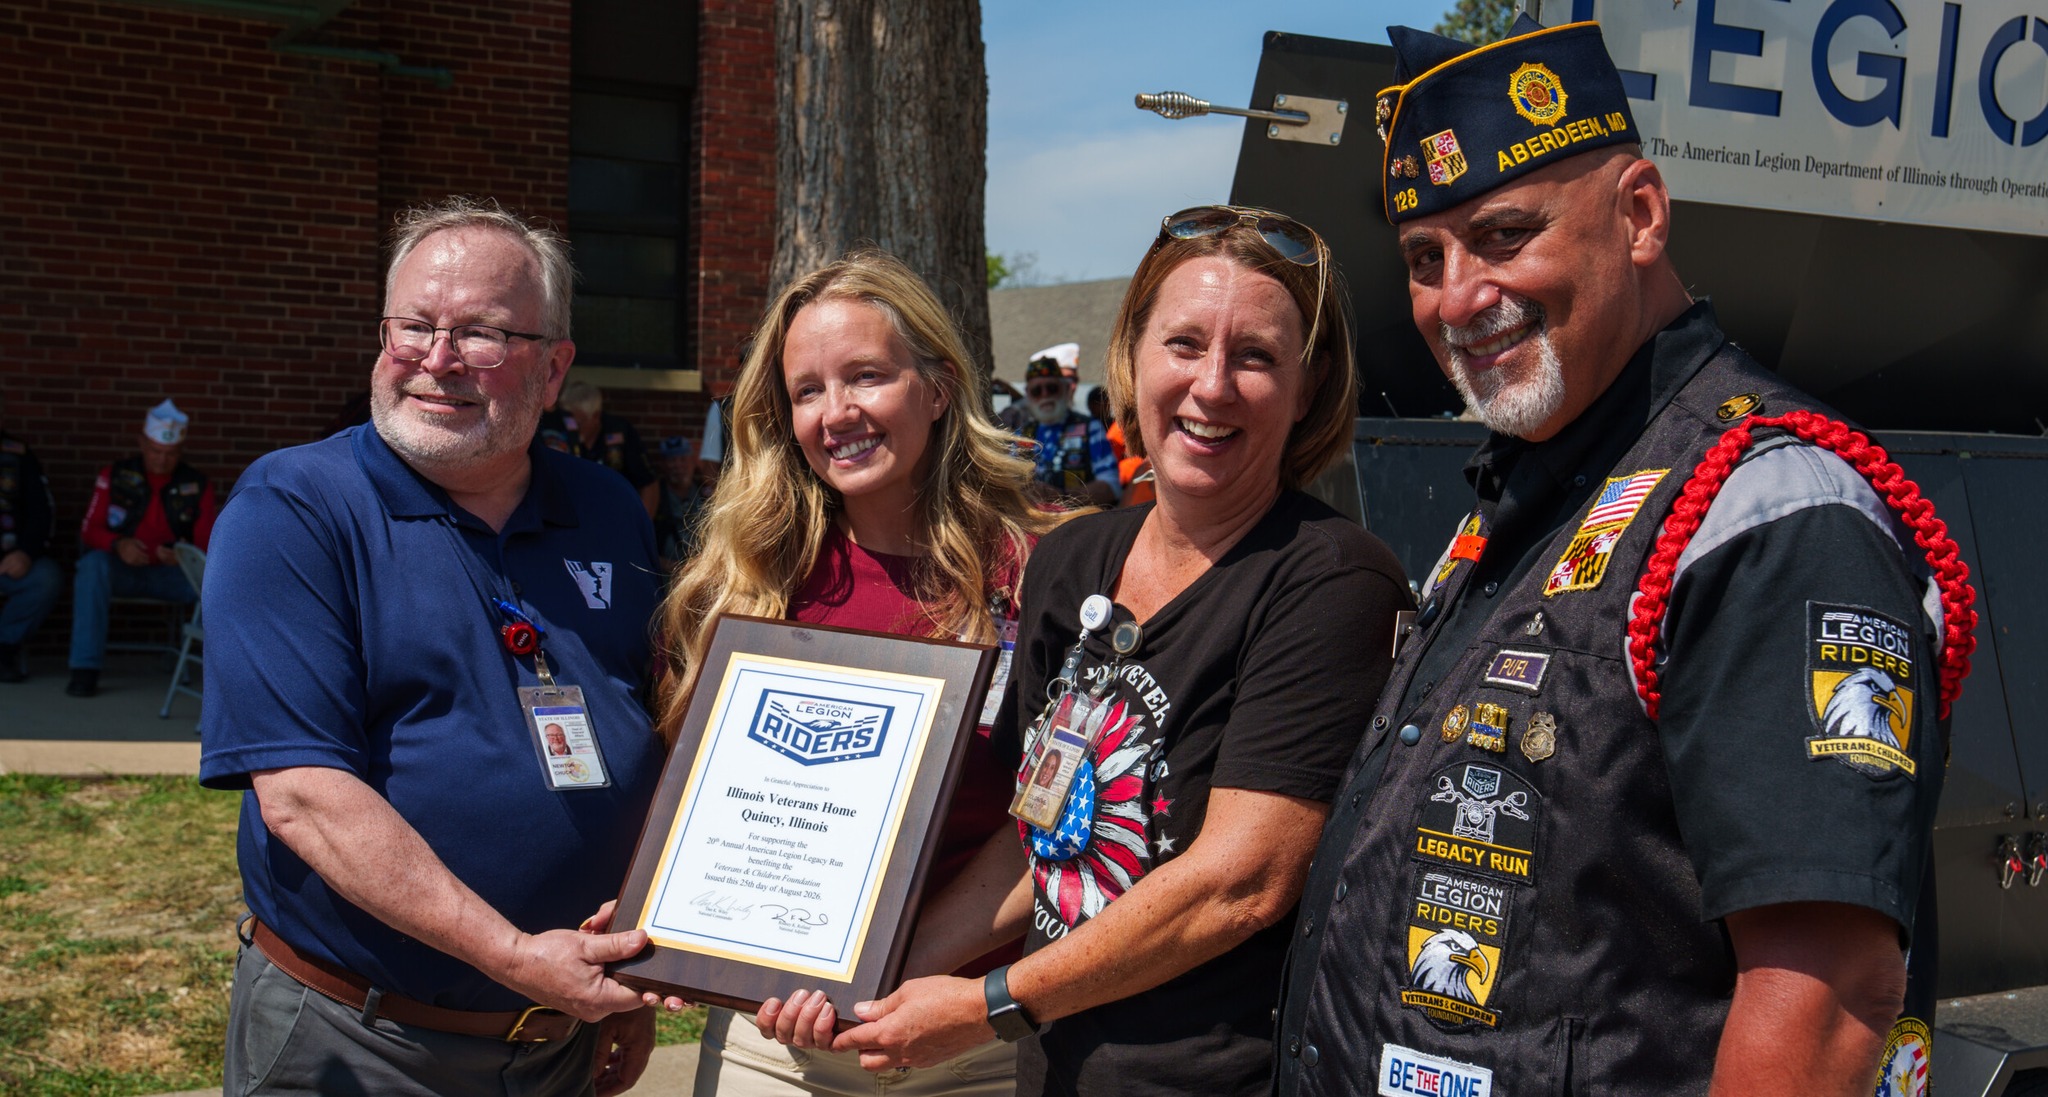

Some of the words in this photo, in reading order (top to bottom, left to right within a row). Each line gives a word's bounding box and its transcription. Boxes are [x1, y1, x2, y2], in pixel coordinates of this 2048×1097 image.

[1517, 71, 1554, 98] AMERICAN
[1530, 101, 1558, 117] LEGION
[1497, 116, 1608, 172] ABERDEEN,
[1608, 111, 1627, 132] MD
[1651, 137, 1678, 158] The
[1682, 141, 1750, 166] American
[1755, 150, 1801, 172] Legion
[1804, 155, 1883, 181] Department
[1886, 166, 1902, 183] of
[1902, 167, 1947, 188] Illinois
[1949, 172, 1998, 195] through
[1393, 187, 1418, 212] 128
[1852, 614, 1908, 639] AMERICAN
[1821, 621, 1909, 658] LEGION
[1498, 658, 1529, 679] PUFL
[1820, 644, 1910, 678] RIDERS
[796, 704, 852, 719] LEGION
[814, 702, 853, 712] AMERICAN
[762, 712, 874, 755] RIDERS
[1815, 742, 1871, 753] VETERANS
[1466, 776, 1496, 793] RIDERS
[726, 786, 765, 803] Illinois
[769, 793, 820, 812] Veterans
[821, 802, 857, 818] Home
[741, 808, 785, 828] Quincy,
[788, 816, 829, 833] Illinois
[748, 832, 760, 841] For
[761, 835, 796, 849] supporting
[797, 841, 808, 849] the
[720, 839, 744, 850] Annual
[745, 844, 777, 856] American
[778, 849, 802, 861] Legion
[802, 854, 828, 867] Legacy
[828, 859, 844, 868] Run
[747, 856, 782, 871] benefiting
[782, 862, 793, 871] the
[1416, 836, 1486, 866] LEGACY
[1490, 852, 1529, 877] RUN
[704, 872, 725, 883] Issued
[726, 875, 739, 885] this
[739, 878, 755, 889] 25th
[755, 882, 768, 892] day
[778, 886, 803, 897] August
[714, 862, 742, 874] Veterans
[743, 867, 751, 875] &
[751, 869, 781, 882] Children
[782, 874, 821, 888] Foundation
[1421, 881, 1501, 916] LEGION
[1446, 877, 1504, 899] AMERICAN
[1417, 902, 1498, 936] RIDERS
[1405, 994, 1444, 1007] VETERANS
[1450, 1002, 1493, 1022] CHILDREN
[1427, 1008, 1464, 1025] FOUNDATION
[1389, 1057, 1416, 1093] BE
[1416, 1069, 1440, 1093] THE
[1440, 1071, 1482, 1097] ONE
